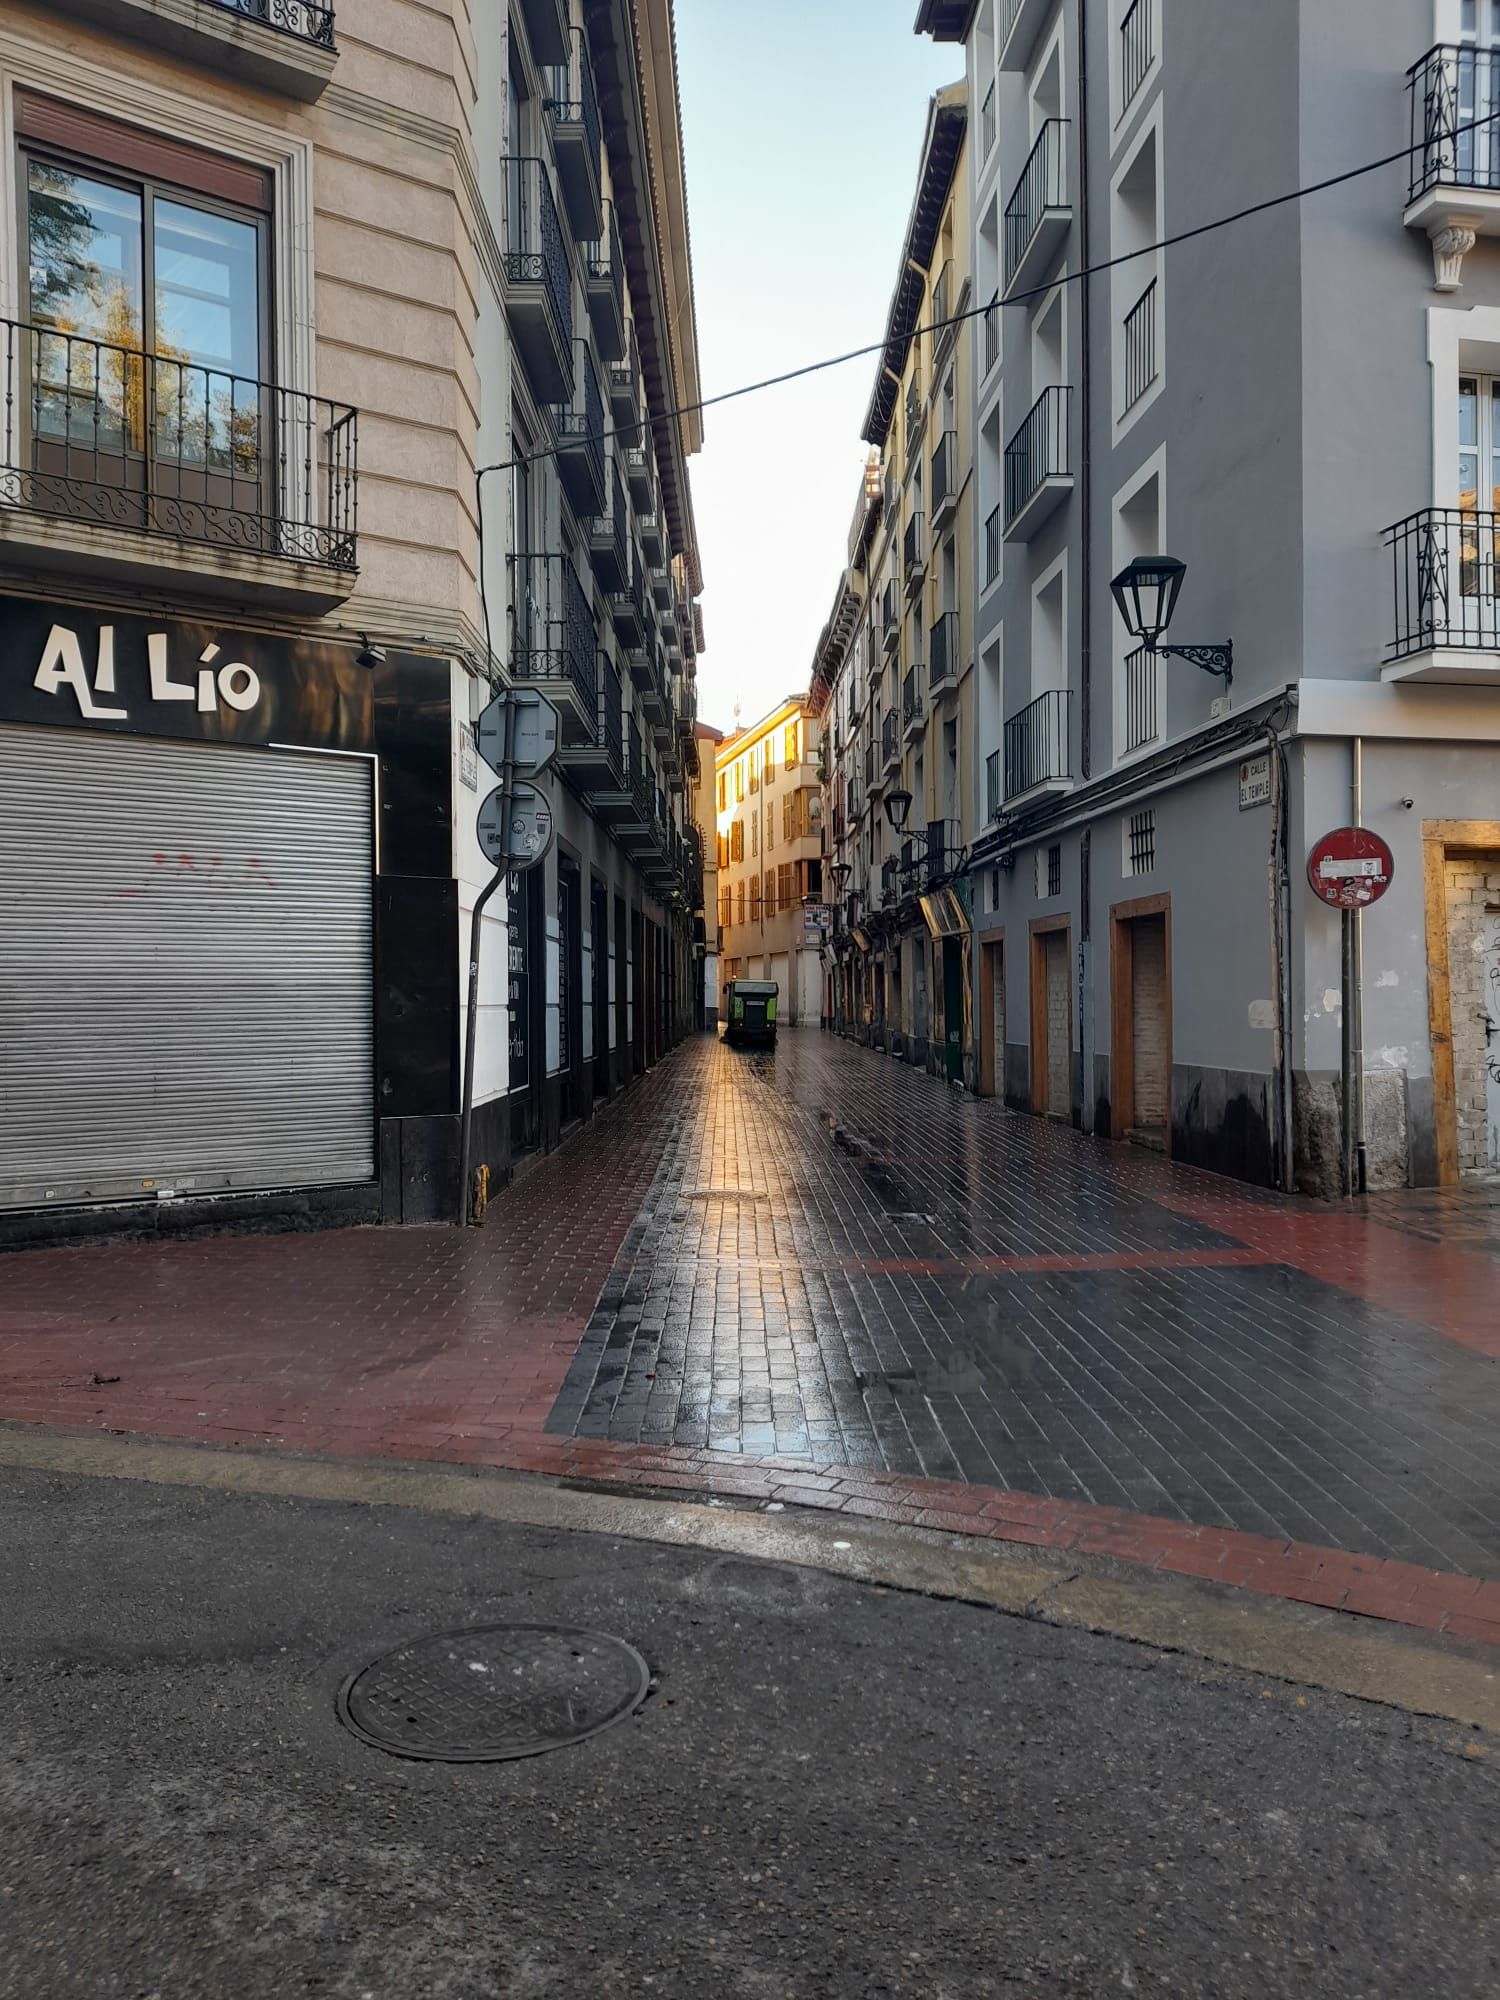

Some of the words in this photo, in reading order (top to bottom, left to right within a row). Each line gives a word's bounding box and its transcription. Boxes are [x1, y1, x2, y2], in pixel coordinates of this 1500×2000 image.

[1250, 761, 1267, 776] CALLE
[1241, 788, 1248, 802] EL
[1248, 780, 1270, 800] TEMPLE
